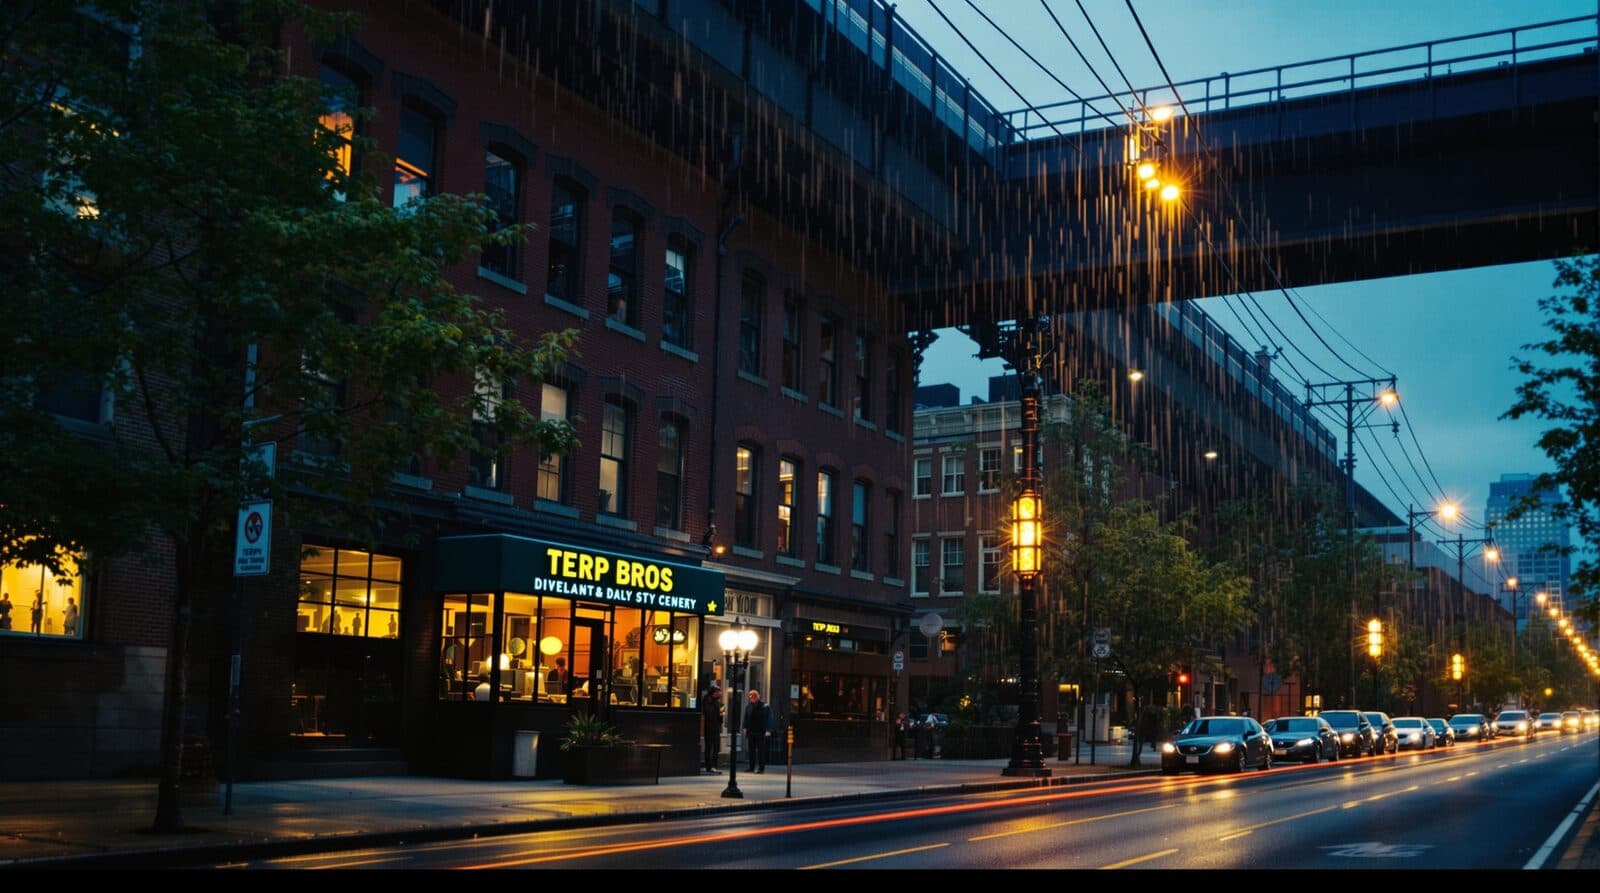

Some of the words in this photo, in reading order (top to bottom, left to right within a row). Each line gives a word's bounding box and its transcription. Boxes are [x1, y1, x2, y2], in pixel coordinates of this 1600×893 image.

[547, 548, 609, 582] TERP
[616, 559, 673, 592] BROS
[606, 587, 632, 602] DALY
[635, 591, 656, 605] STY
[658, 594, 697, 610] CENERY
